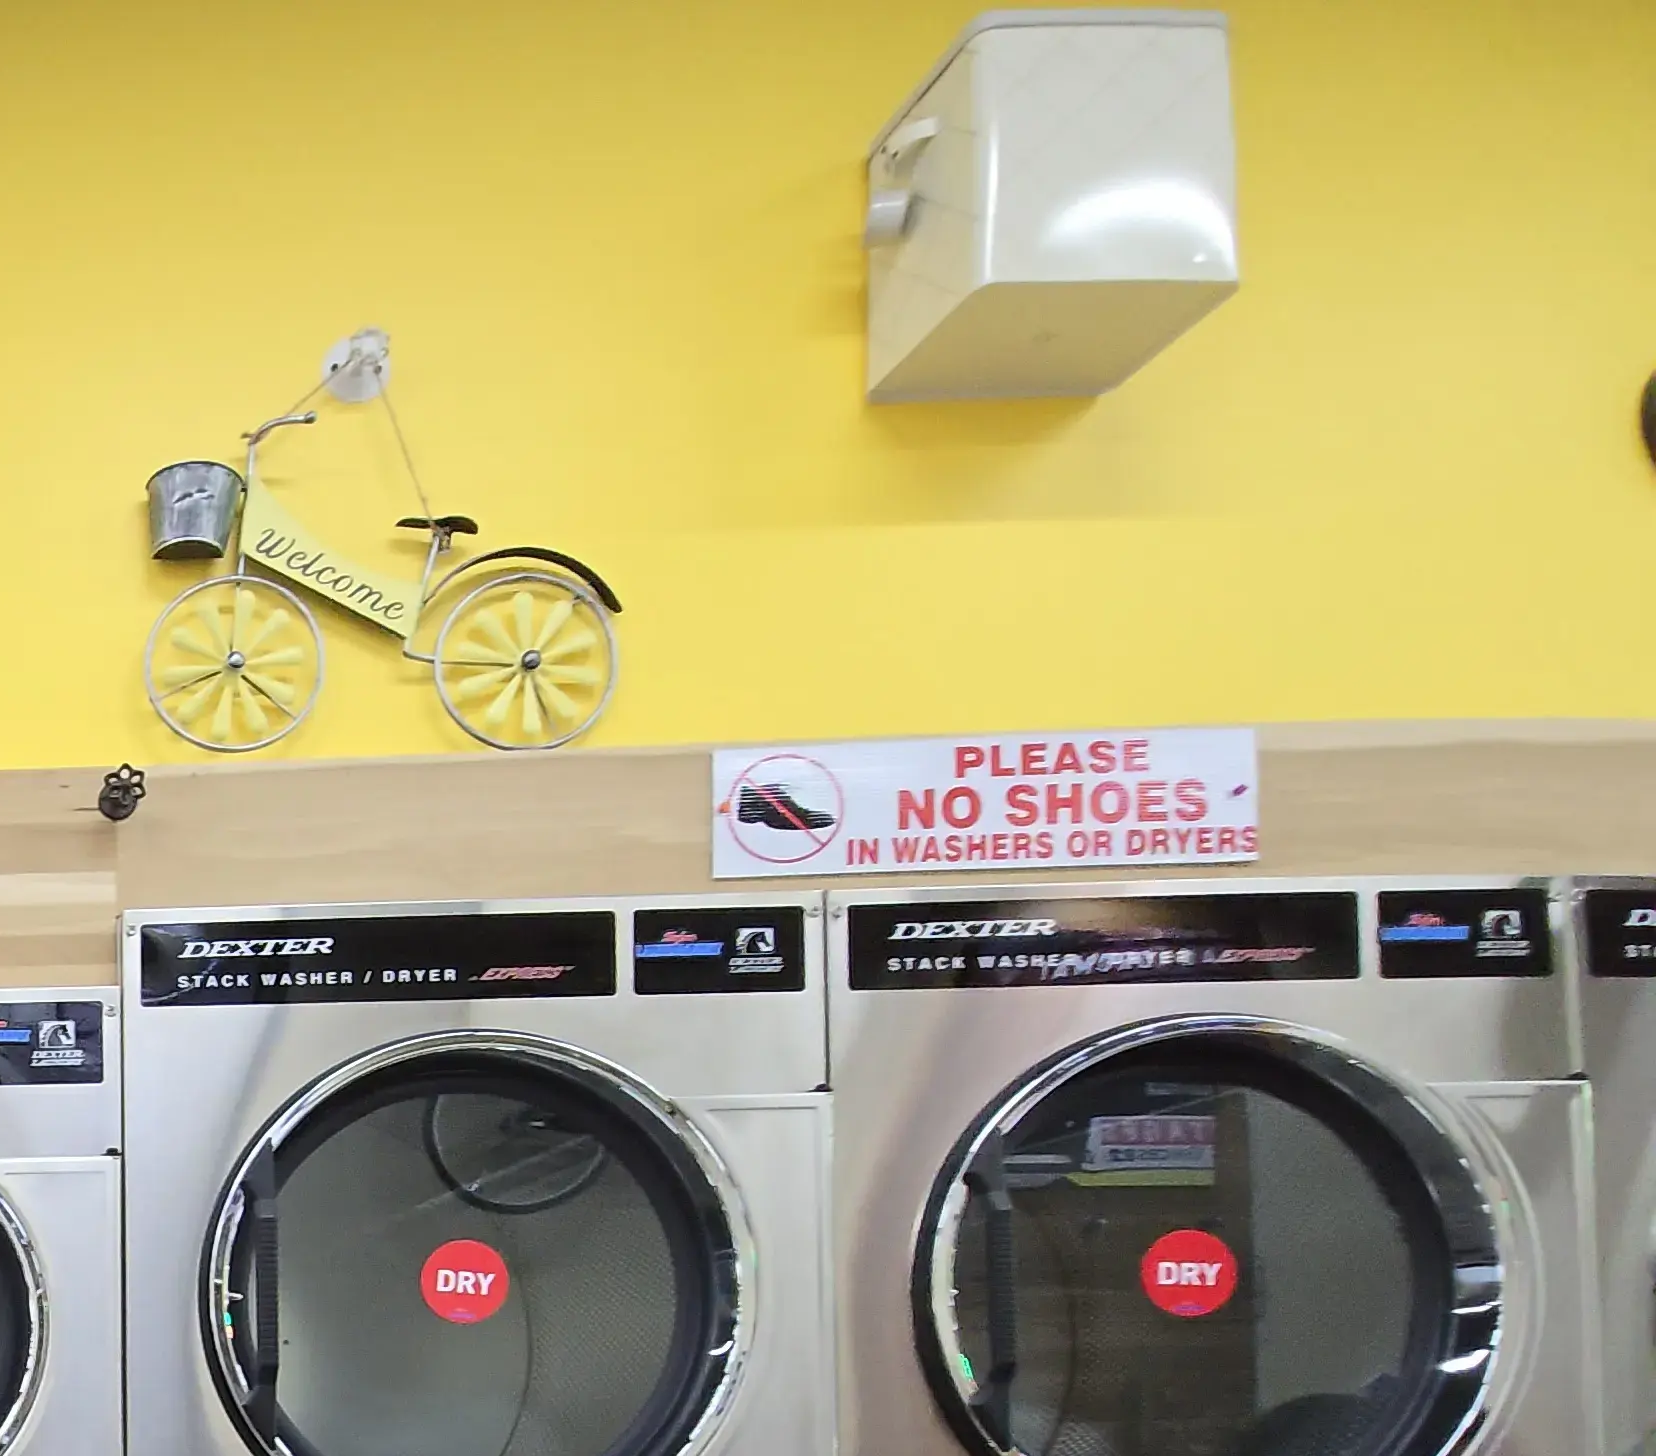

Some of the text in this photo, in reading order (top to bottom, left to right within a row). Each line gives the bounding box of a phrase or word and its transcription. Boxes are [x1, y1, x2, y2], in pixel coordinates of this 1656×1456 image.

[255, 528, 405, 620] Welcome
[955, 739, 1150, 779] PLEASE
[898, 779, 1208, 831] NO SHOES
[846, 825, 1260, 865] IN WASHERS OR DRYERS
[887, 918, 1058, 940] DEXTER
[178, 937, 335, 958] DEXTER
[887, 954, 966, 972] STACK
[178, 973, 250, 989] STACK
[260, 971, 353, 987] WASHER
[382, 968, 458, 984] DRYER
[436, 1268, 495, 1296] DRY
[1157, 1261, 1222, 1286] DRY
